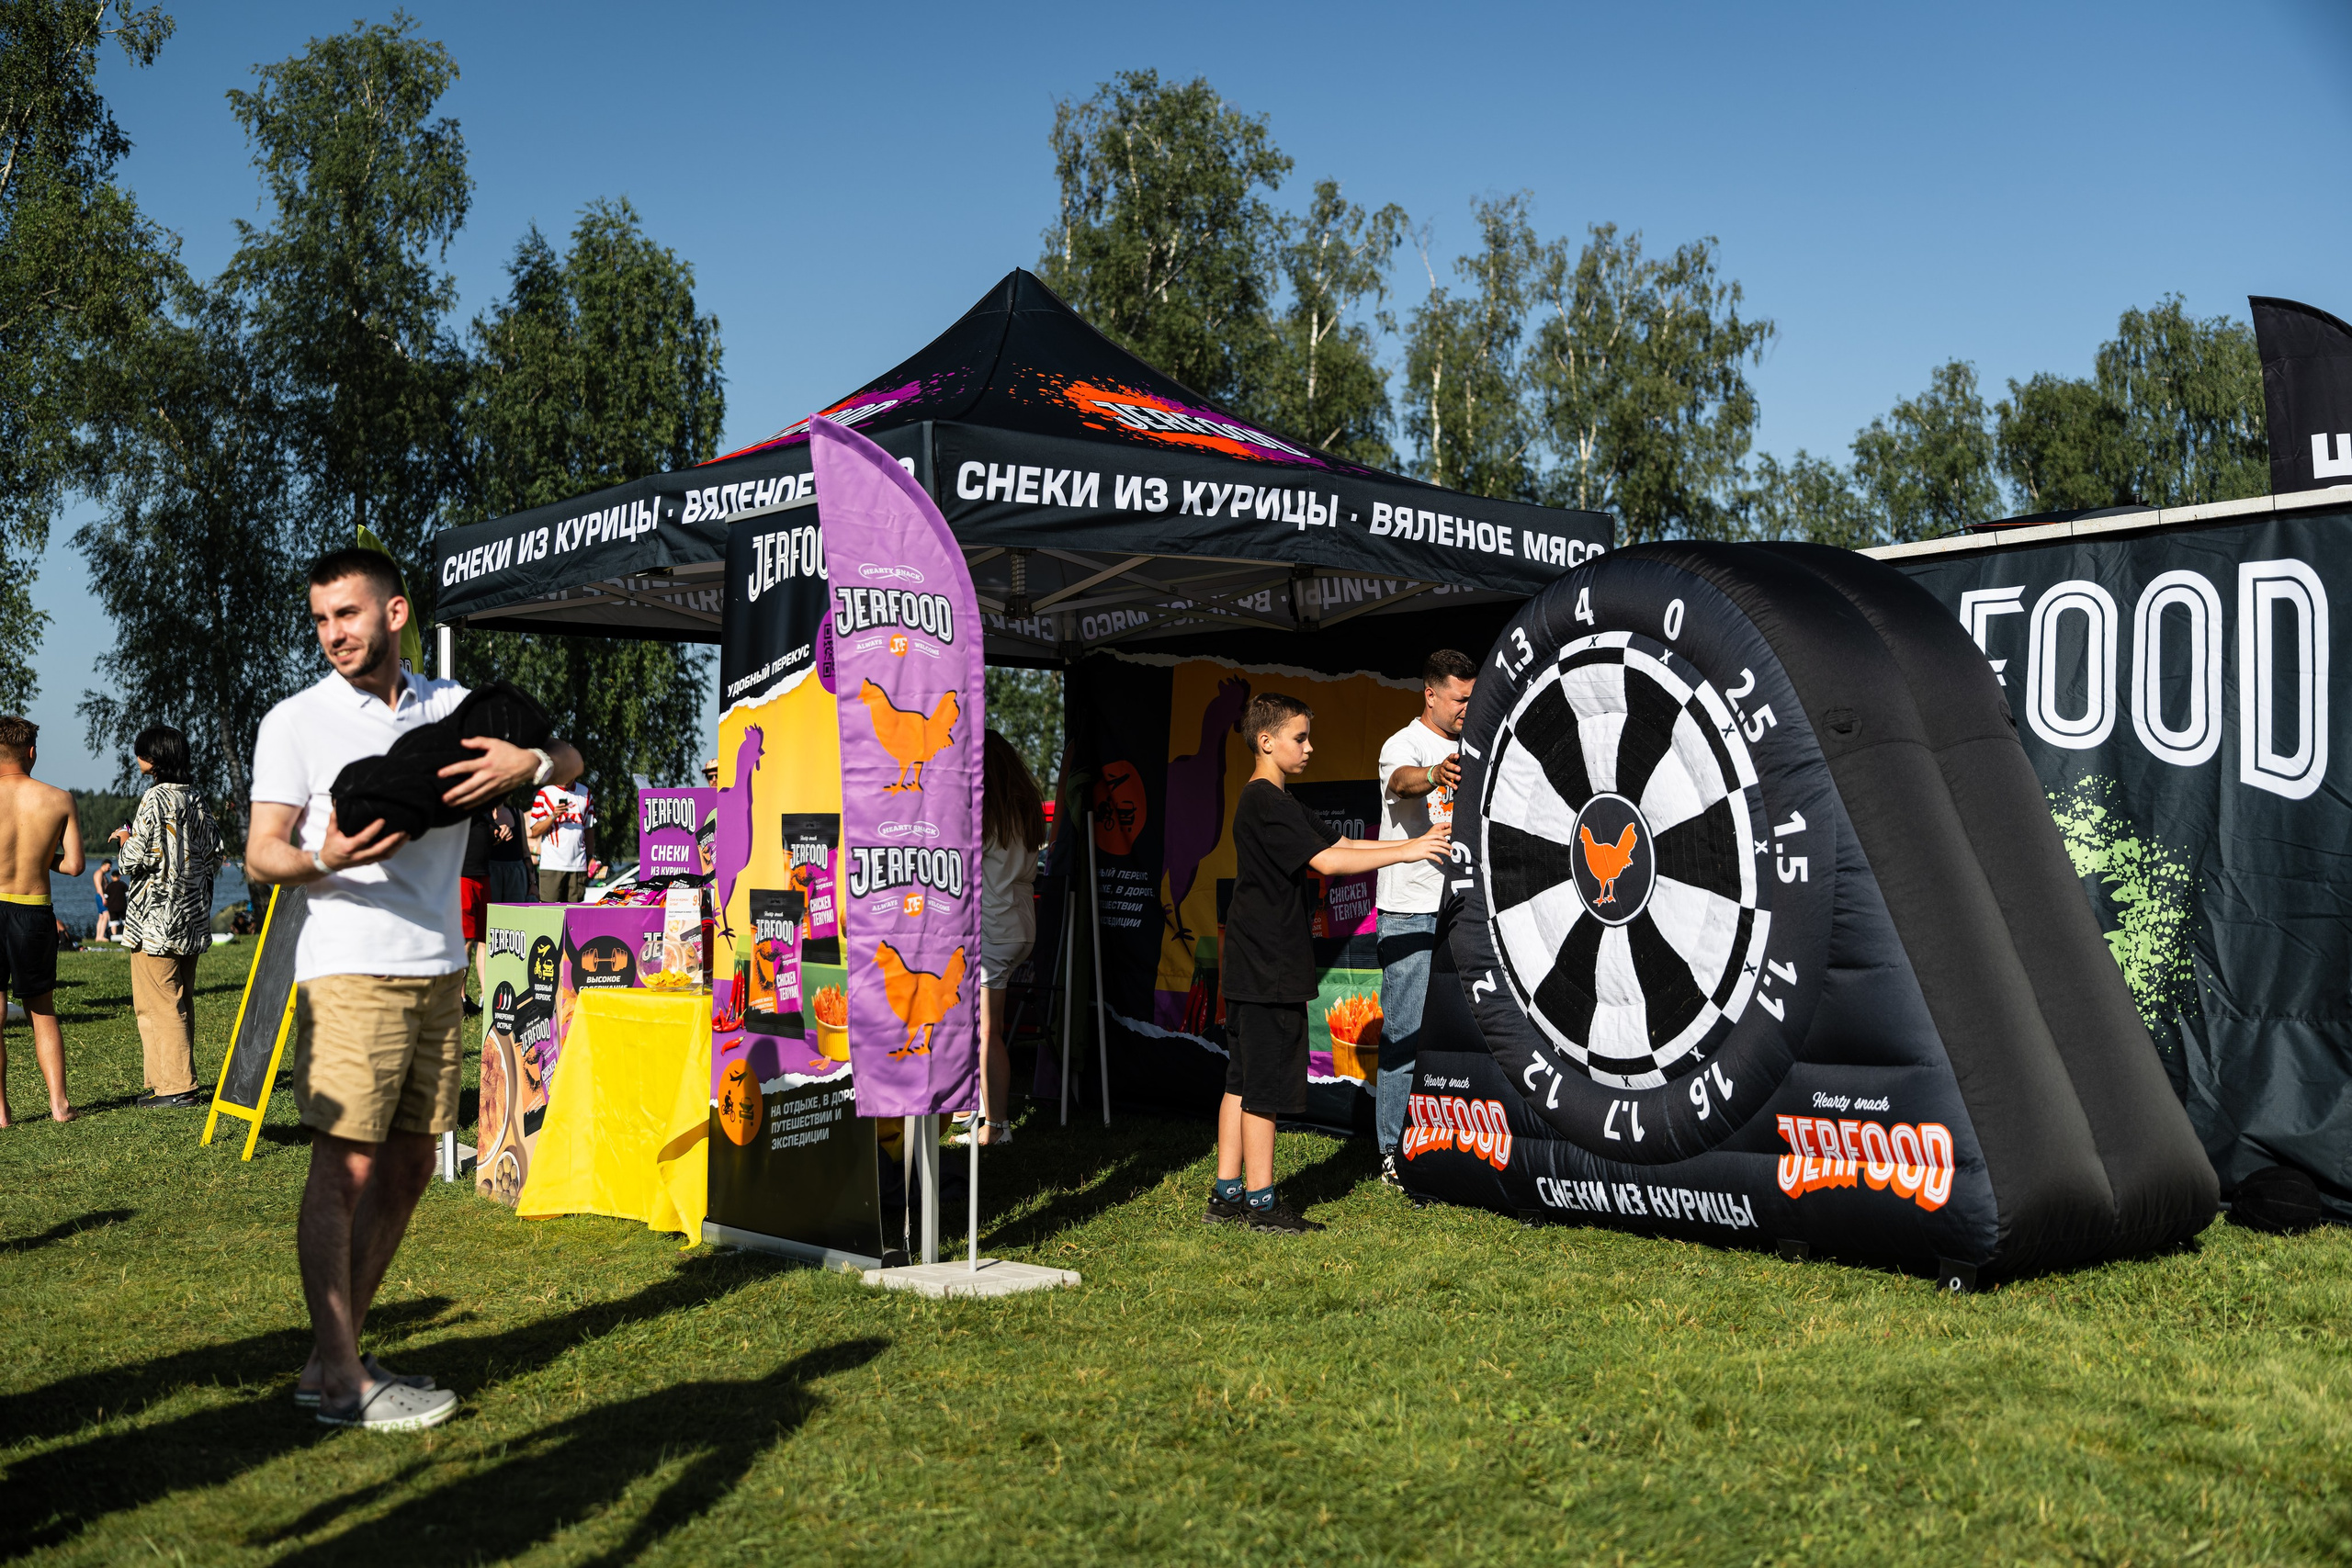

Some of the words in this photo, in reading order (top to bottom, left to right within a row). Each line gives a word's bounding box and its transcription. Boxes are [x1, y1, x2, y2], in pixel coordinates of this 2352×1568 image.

[956, 460, 1100, 508] СНЕКИ
[1114, 474, 1169, 513] ИЗ
[1180, 479, 1339, 531] КУРИЦЫ
[1369, 502, 1514, 557] ВЯЛЕНОЕ
[442, 536, 513, 588] СНЕКИ
[517, 527, 548, 566] ИЗ
[554, 496, 661, 555] КУРИЦЫ
[748, 525, 829, 603] JERFOO
[863, 567, 893, 576] HEARTY
[896, 567, 921, 581] SNACK
[836, 587, 954, 644] JERFOOD
[1574, 586, 1595, 626] 4
[1663, 598, 1685, 641] 0
[856, 638, 883, 650] ALWAYS
[914, 642, 940, 656] WELCOME
[1495, 626, 1534, 682] 1.3
[727, 662, 770, 698] УДОБНЫЙ
[771, 644, 810, 677] ПЕРЕКУС
[1960, 558, 2329, 800] FOOD
[1724, 667, 1778, 744] 2.5
[643, 797, 696, 834] JERFOOD
[882, 825, 912, 834] HEARTY
[912, 825, 937, 835] SNACK
[650, 845, 689, 862] СНЕКИ
[790, 843, 828, 870] JERFOOD
[1773, 810, 1809, 884] 1.5
[650, 866, 660, 875] ИЗ
[850, 847, 963, 897] JERFOOD
[1117, 870, 1148, 880] ПЕРЕКУС
[1451, 841, 1475, 897] 1.9
[872, 899, 898, 911] ALWAYS
[1115, 886, 1124, 894] В
[1329, 882, 1368, 906] CHICKEN
[1333, 898, 1372, 922] TERIYAKI
[489, 928, 526, 959] JERFOOD
[755, 919, 794, 945] JERFOOD
[586, 976, 621, 984] ВЫСОКОЕ
[520, 1018, 551, 1055] JERFOOD
[1424, 1074, 1447, 1089] Hearty
[1449, 1077, 1470, 1089] snack
[771, 1106, 781, 1118] НА
[783, 1096, 820, 1114] ОТДЫХЕ,
[823, 1094, 829, 1106] В
[831, 1088, 855, 1107] ДОРО
[1813, 1091, 1851, 1111] Hearty
[1854, 1096, 1890, 1111] snack
[771, 1110, 832, 1134] ПУТЕШЕСТВИИ
[835, 1108, 842, 1121] И
[1403, 1094, 1512, 1168] JERFOOD
[1603, 1100, 1645, 1142] 1.7
[772, 1128, 829, 1150] ЭКСПЕДИЦИИ
[1777, 1115, 1954, 1207] JERFOOD
[1536, 1176, 1611, 1213] СНЕКИ
[1611, 1183, 1648, 1214] ИЗ
[1647, 1185, 1758, 1230] КУРИЦЫ
